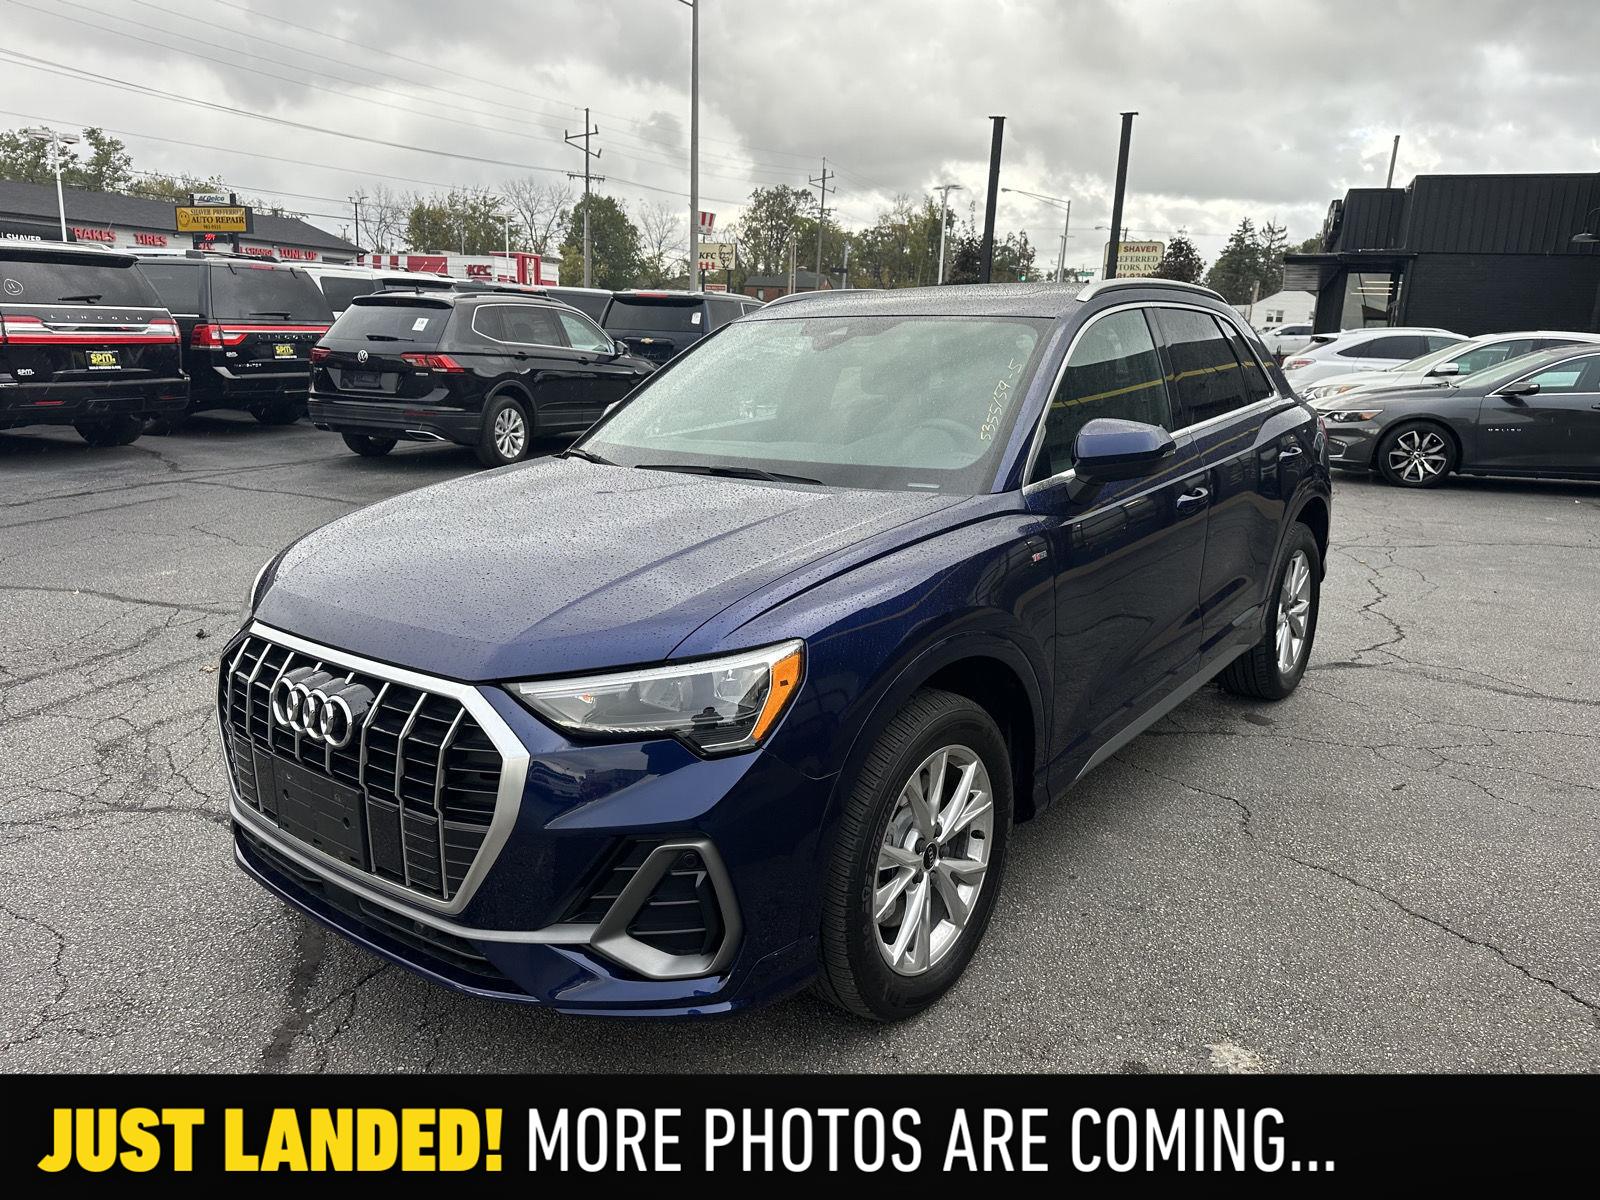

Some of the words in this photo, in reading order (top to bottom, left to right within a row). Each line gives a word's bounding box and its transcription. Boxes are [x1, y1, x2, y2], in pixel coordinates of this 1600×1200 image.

[191, 216, 214, 224] AUTO
[215, 216, 245, 224] REPAIR
[73, 227, 116, 241] RAKES
[134, 233, 168, 246] TIRES
[1123, 245, 1158, 253] SHAVER
[699, 252, 717, 260] KFC
[1119, 255, 1159, 263] EFERRED
[467, 264, 492, 275] KFC
[1118, 263, 1142, 272] TORS,
